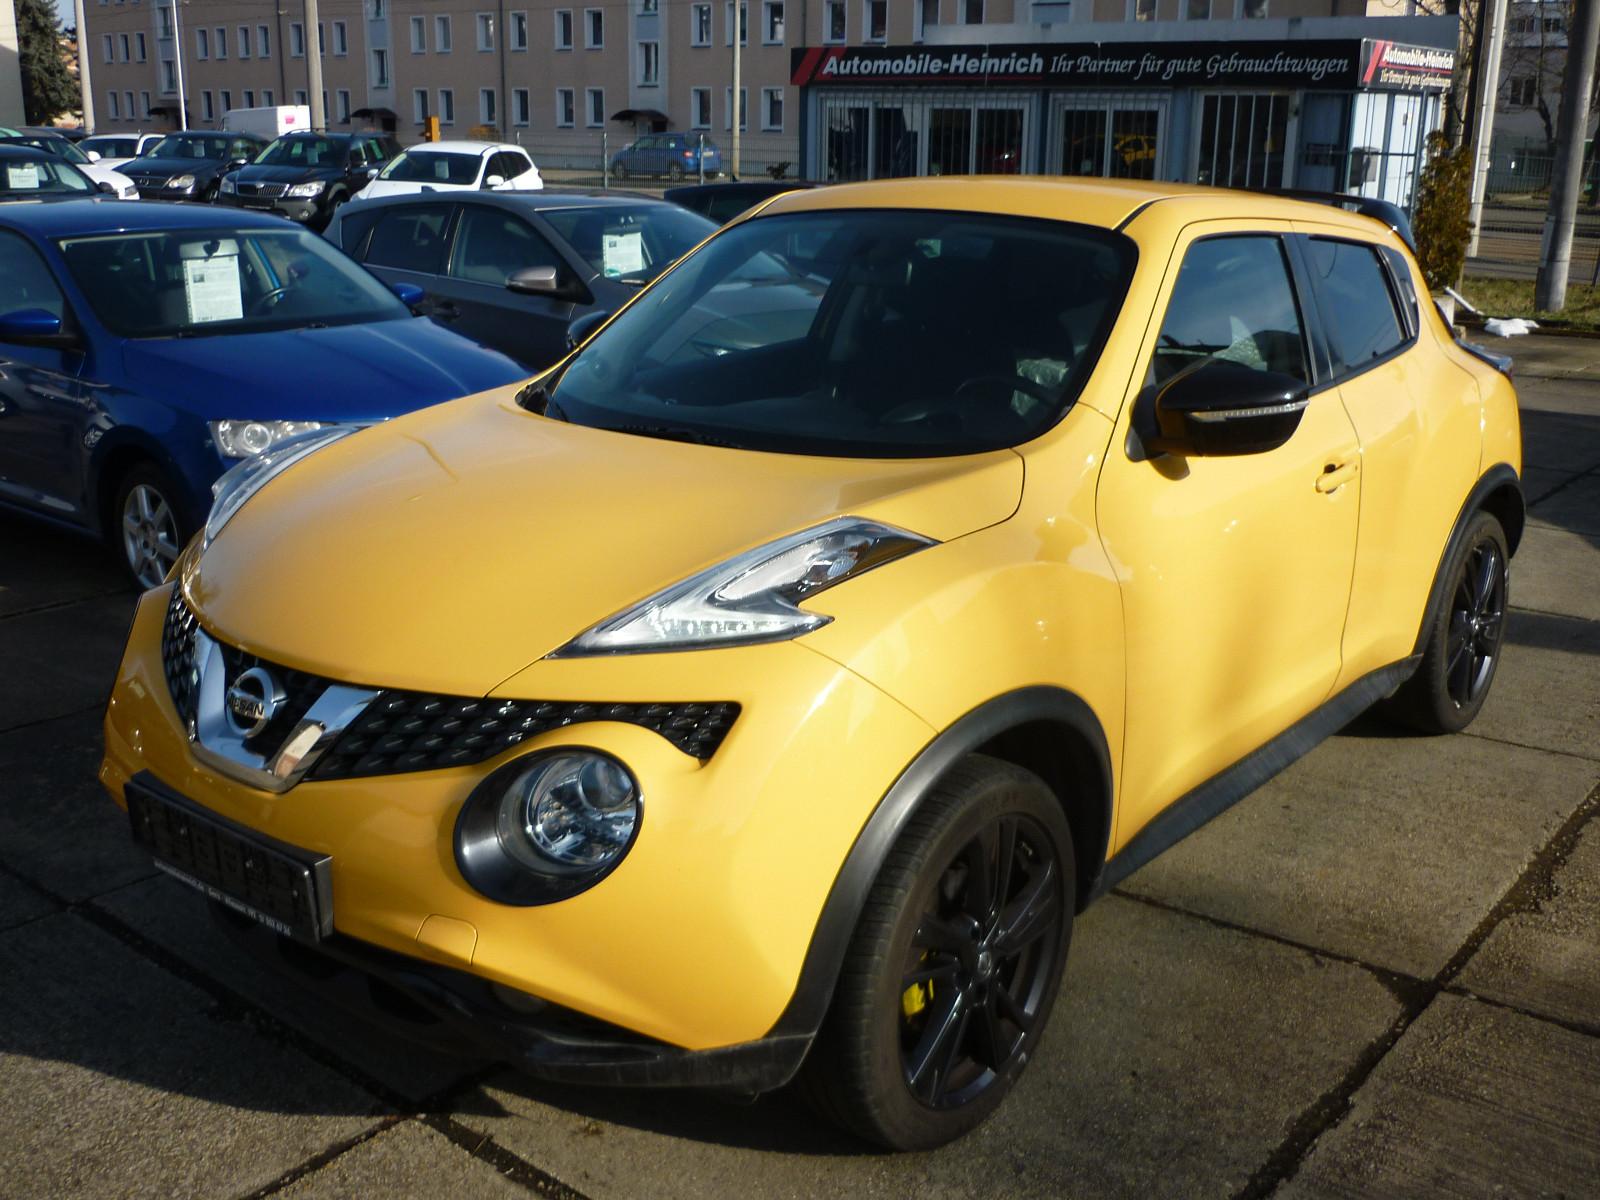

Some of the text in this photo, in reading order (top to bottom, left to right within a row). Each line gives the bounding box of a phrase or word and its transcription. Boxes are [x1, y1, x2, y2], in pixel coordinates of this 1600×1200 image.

[822, 52, 1348, 81] Automobile-Heinrich Ihr Partner für gute Gebrauchtwagen
[1382, 45, 1454, 69] Automobile-Heinrich
